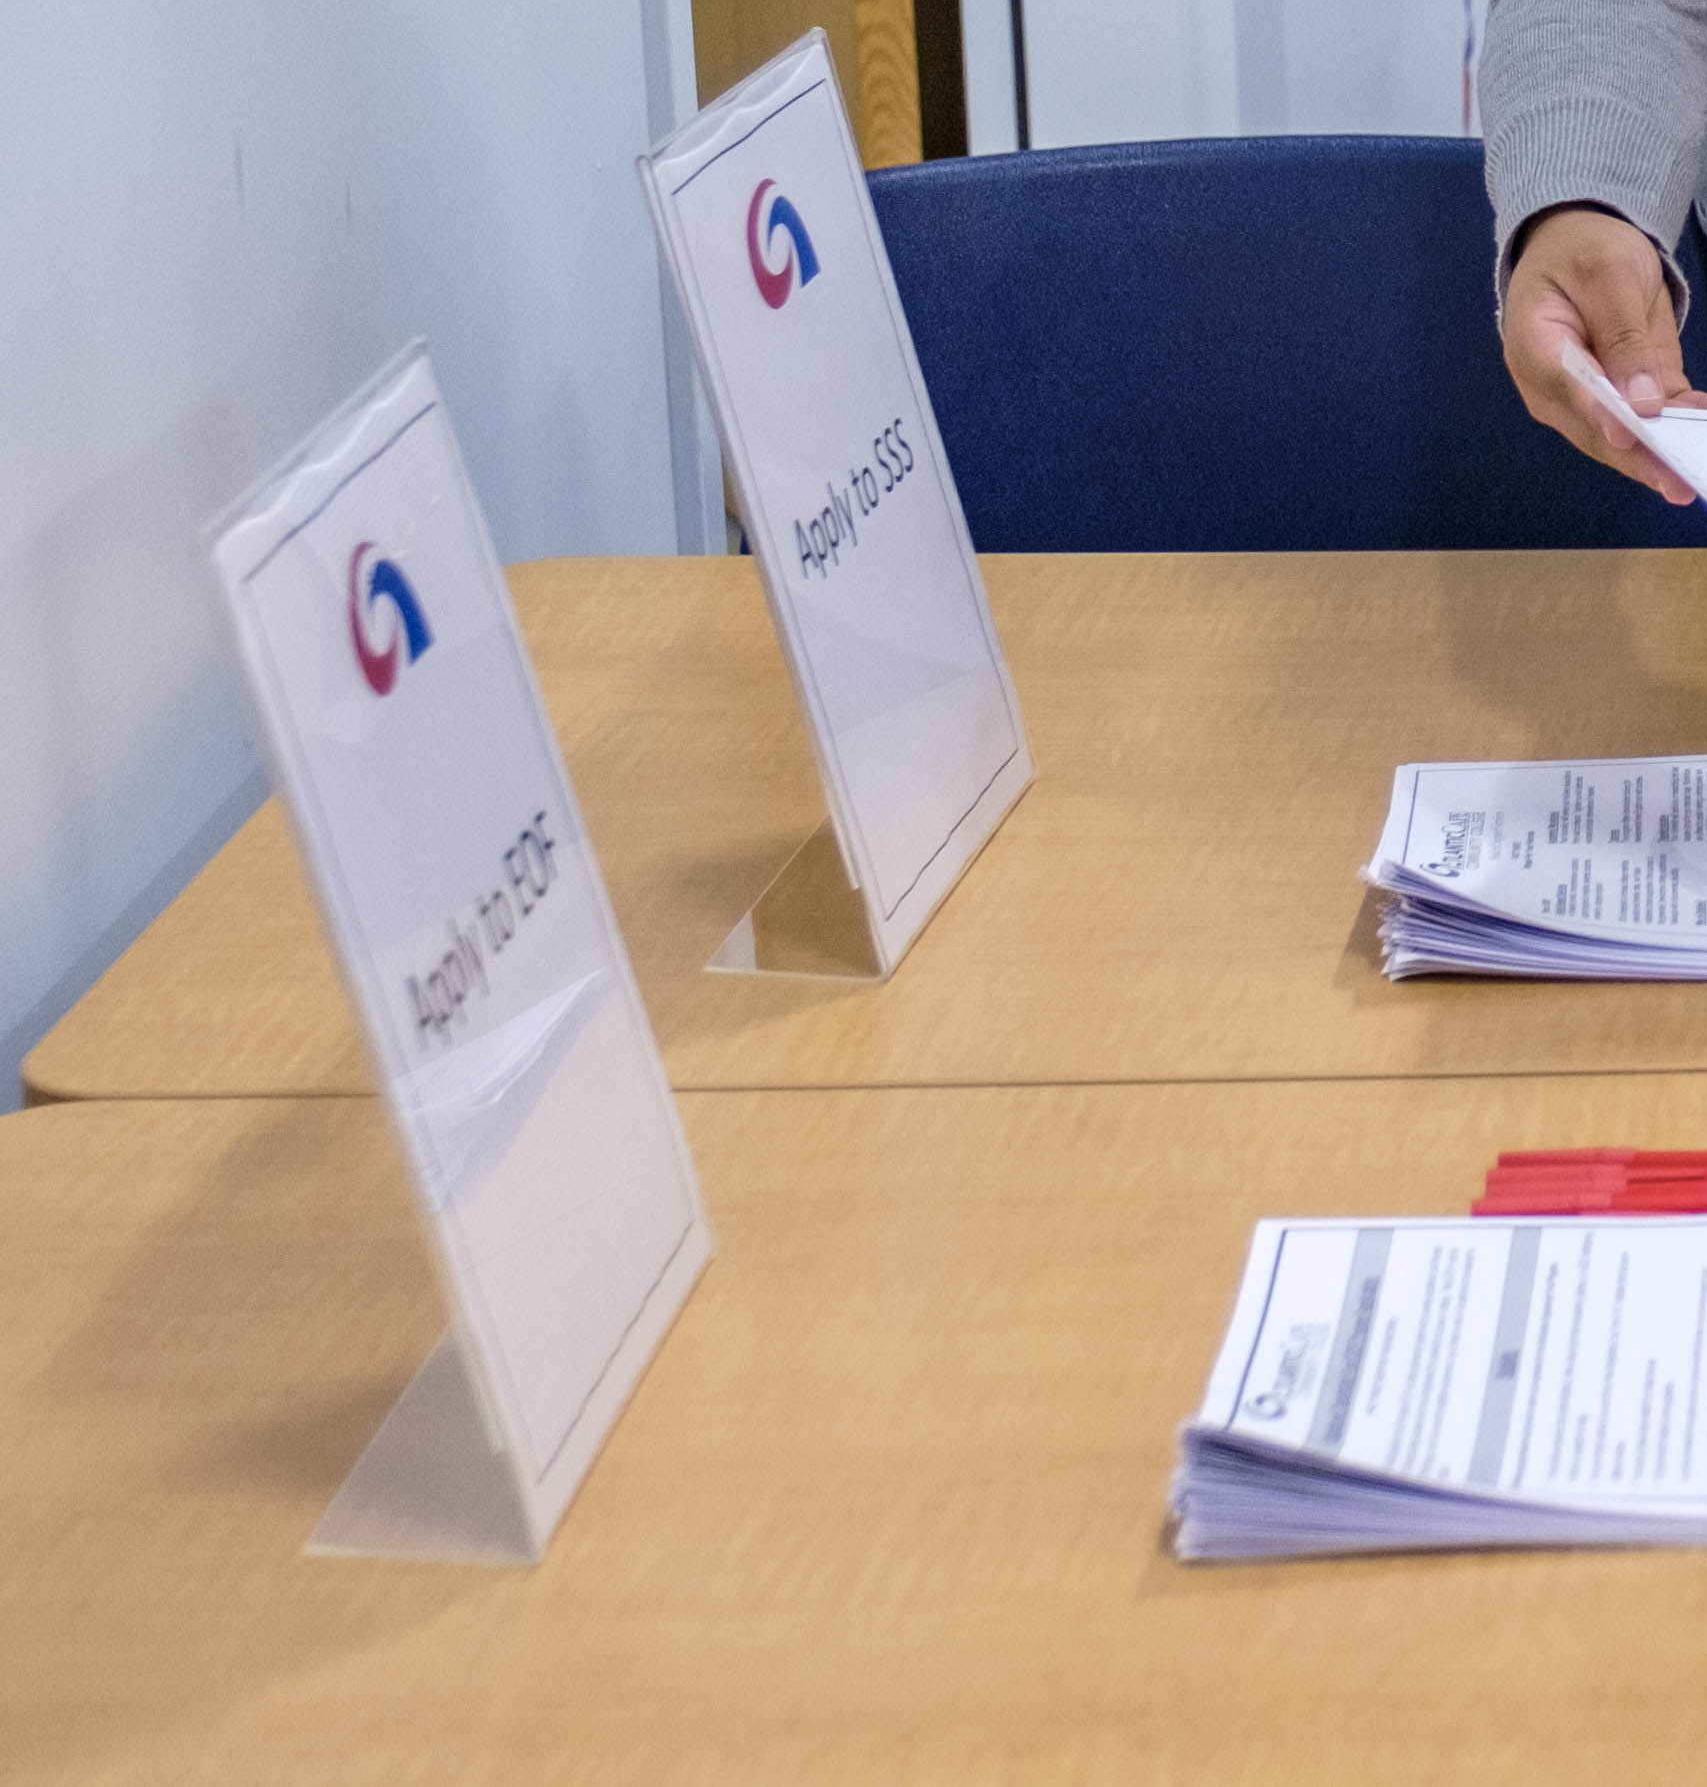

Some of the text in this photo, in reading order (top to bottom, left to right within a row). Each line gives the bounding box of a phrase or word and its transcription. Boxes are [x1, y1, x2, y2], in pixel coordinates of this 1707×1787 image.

[794, 417, 914, 581] Apply to SSS
[404, 810, 559, 1052] Apply to EOF
